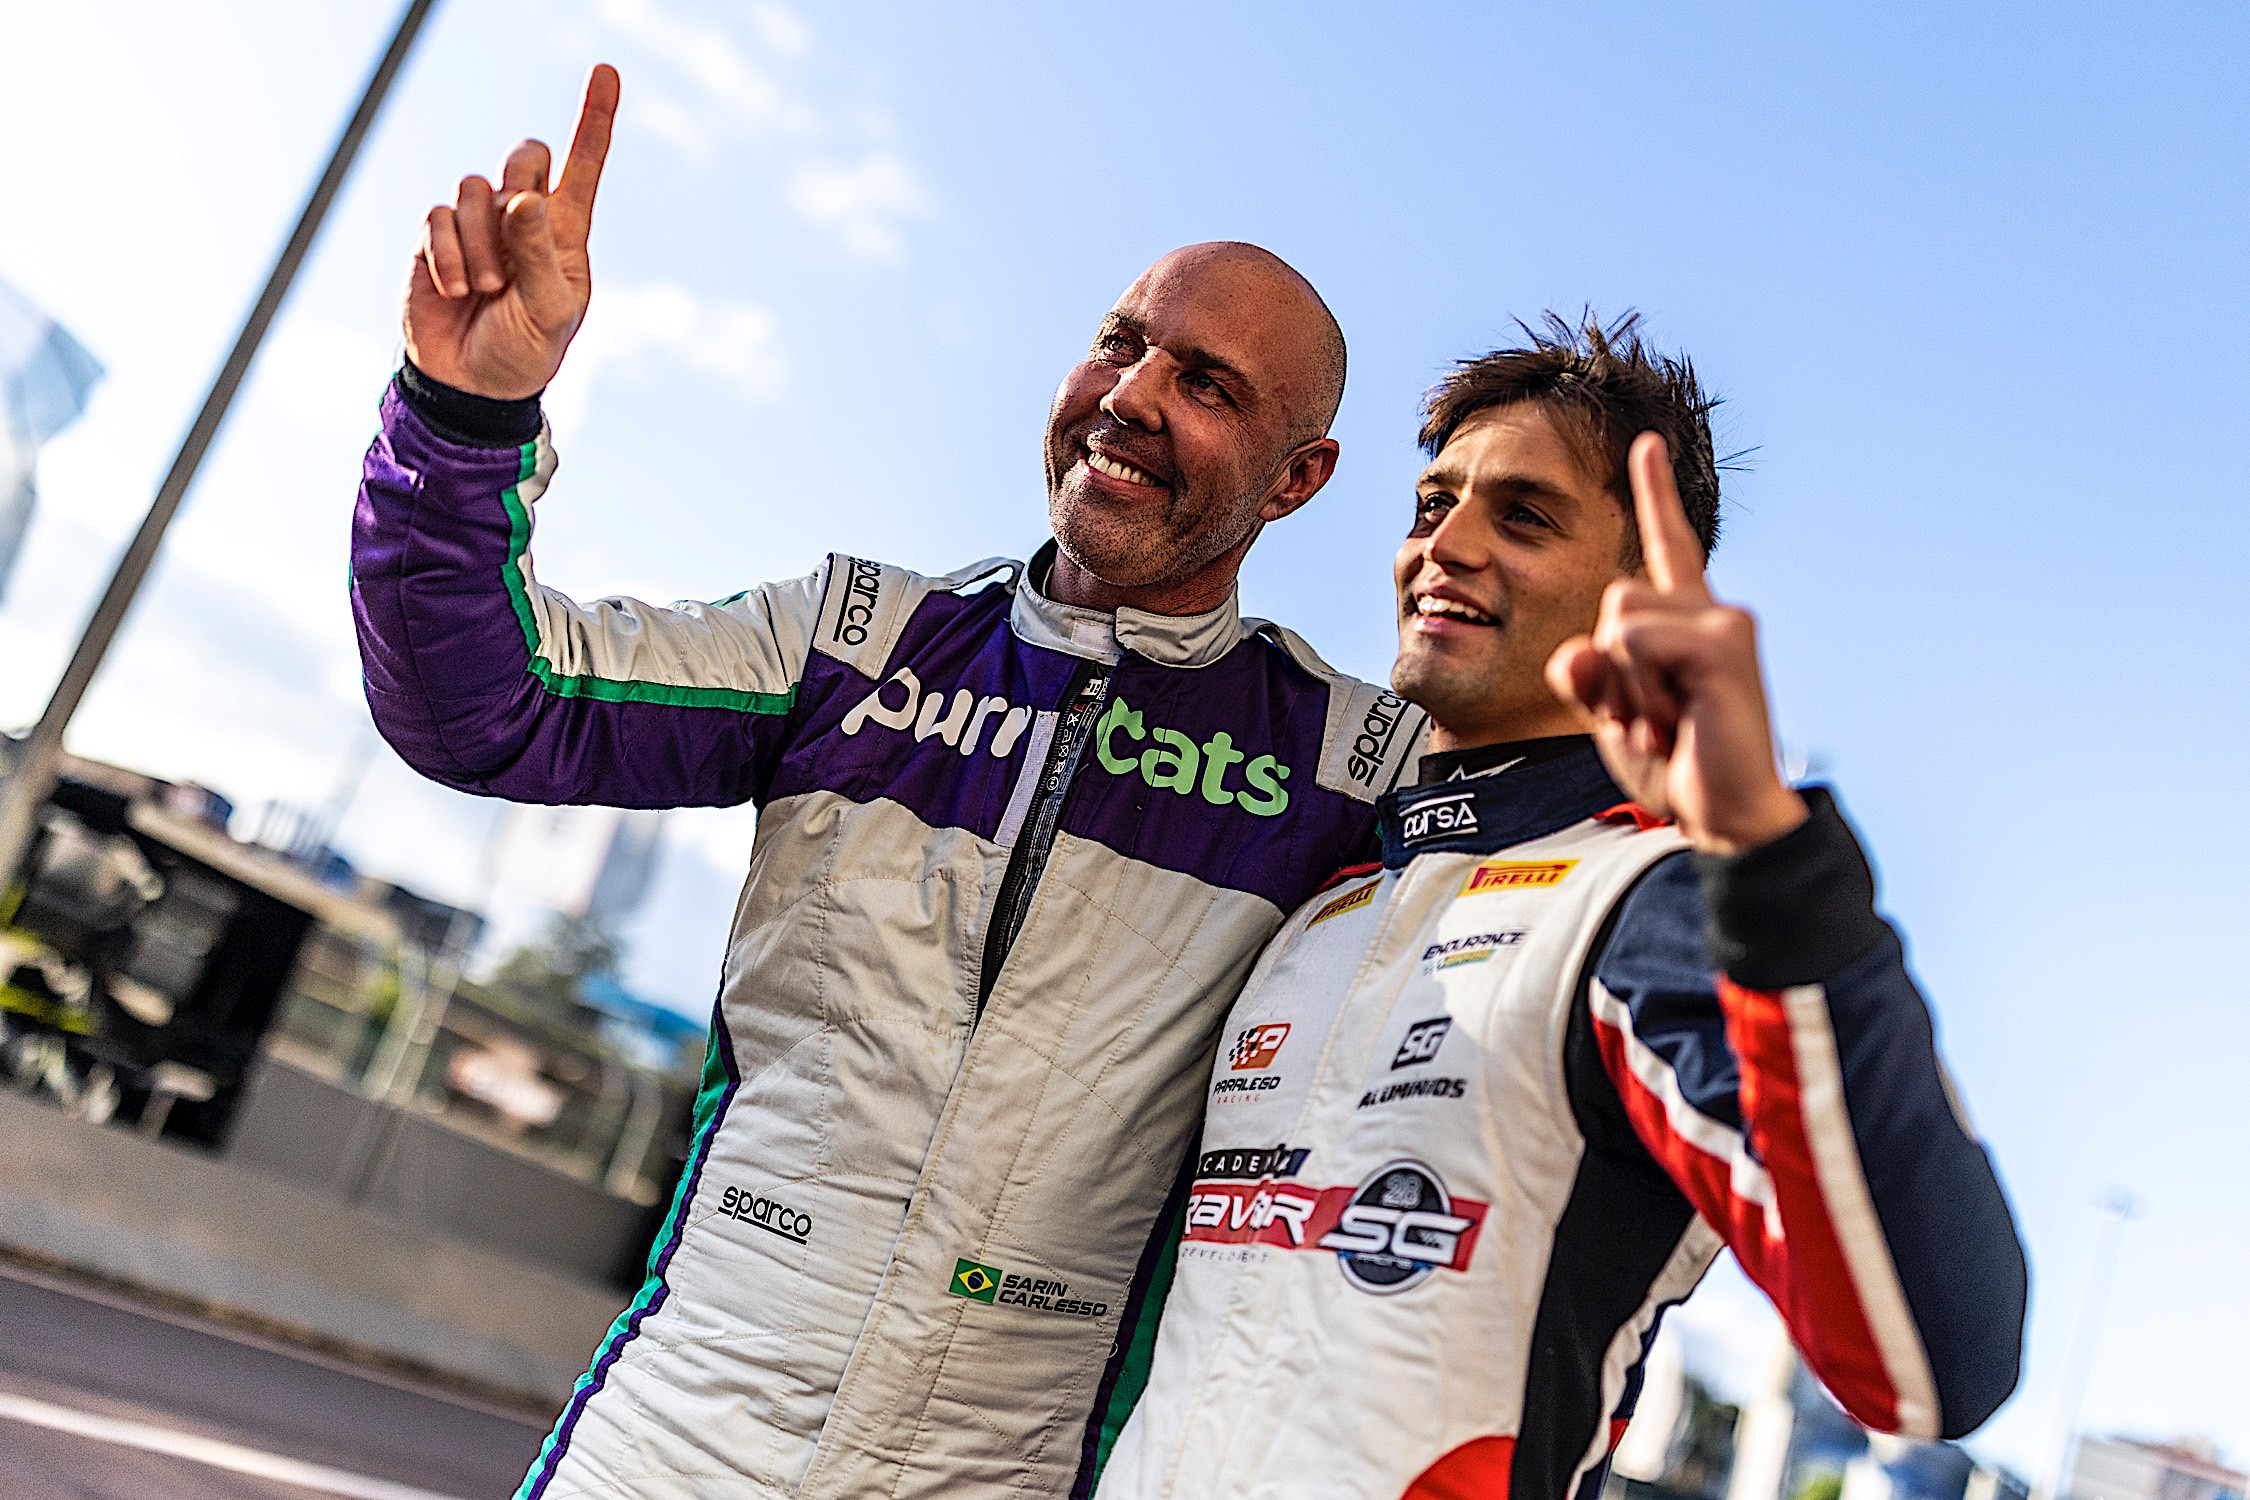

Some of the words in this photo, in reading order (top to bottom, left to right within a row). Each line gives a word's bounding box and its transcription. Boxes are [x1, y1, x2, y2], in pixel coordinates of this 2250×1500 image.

[1469, 865, 1567, 891] PIRELLI
[1422, 931, 1527, 961] ENDURANCE
[1213, 1076, 1281, 1097] PARALEGO
[1217, 1094, 1260, 1104] RACING
[722, 1186, 812, 1238] sparco
[1316, 1205, 1476, 1266] SG
[1002, 1274, 1068, 1298] SARIN
[998, 1289, 1108, 1317] CARLESSO
